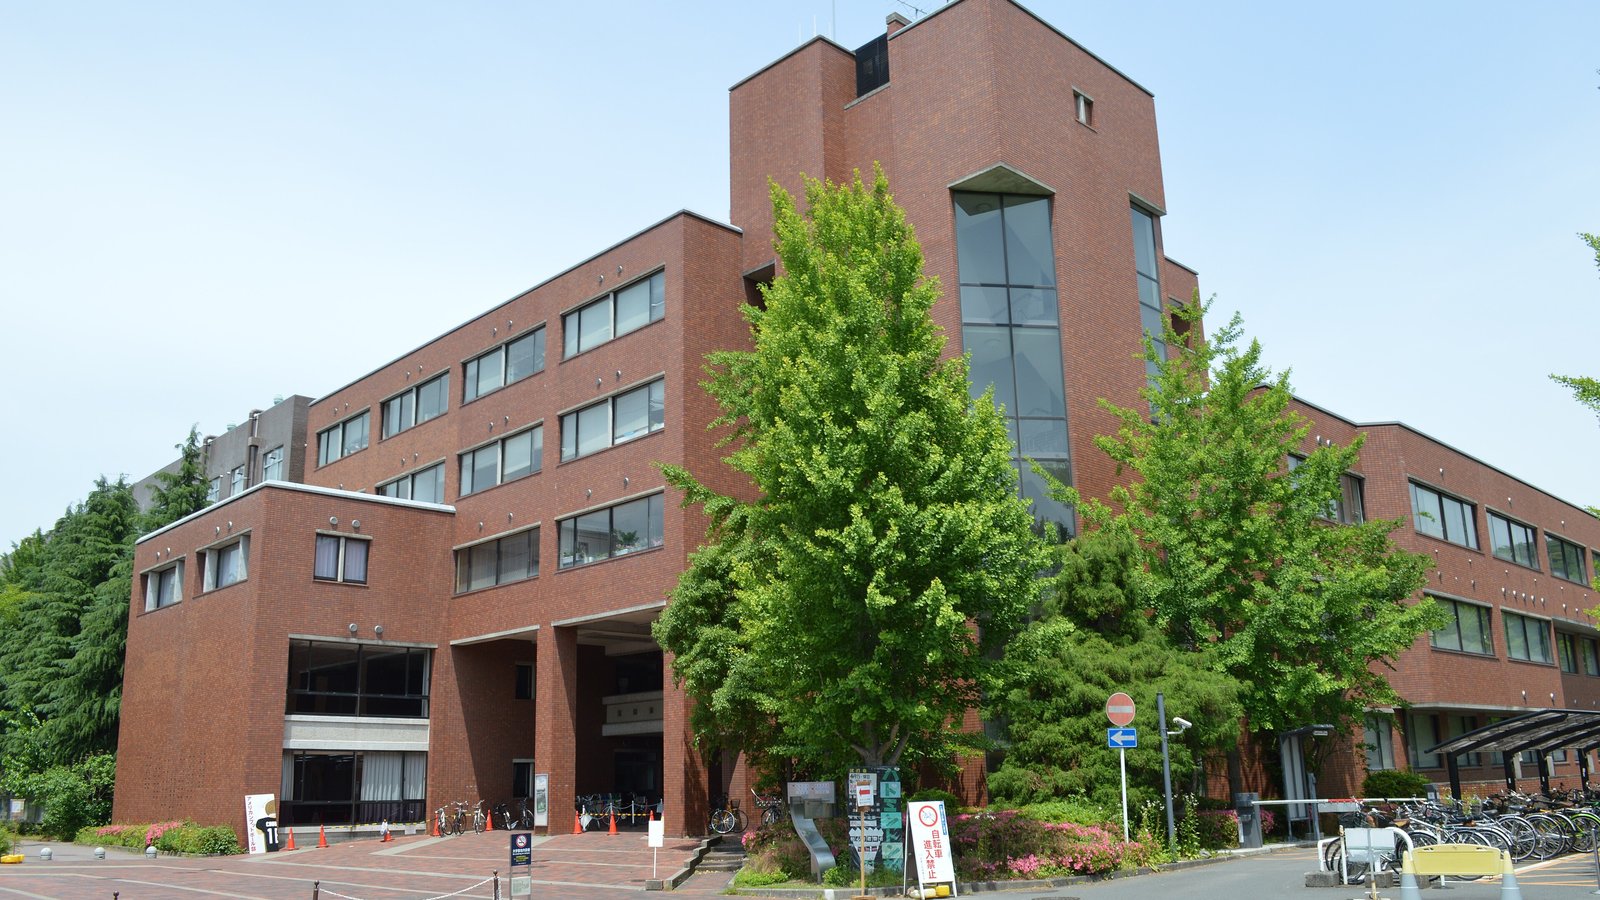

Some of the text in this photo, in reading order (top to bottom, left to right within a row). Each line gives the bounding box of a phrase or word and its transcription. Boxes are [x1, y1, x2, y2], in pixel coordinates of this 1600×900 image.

[923, 839, 937, 879] 進入禁止
[931, 829, 943, 858] 自転車
